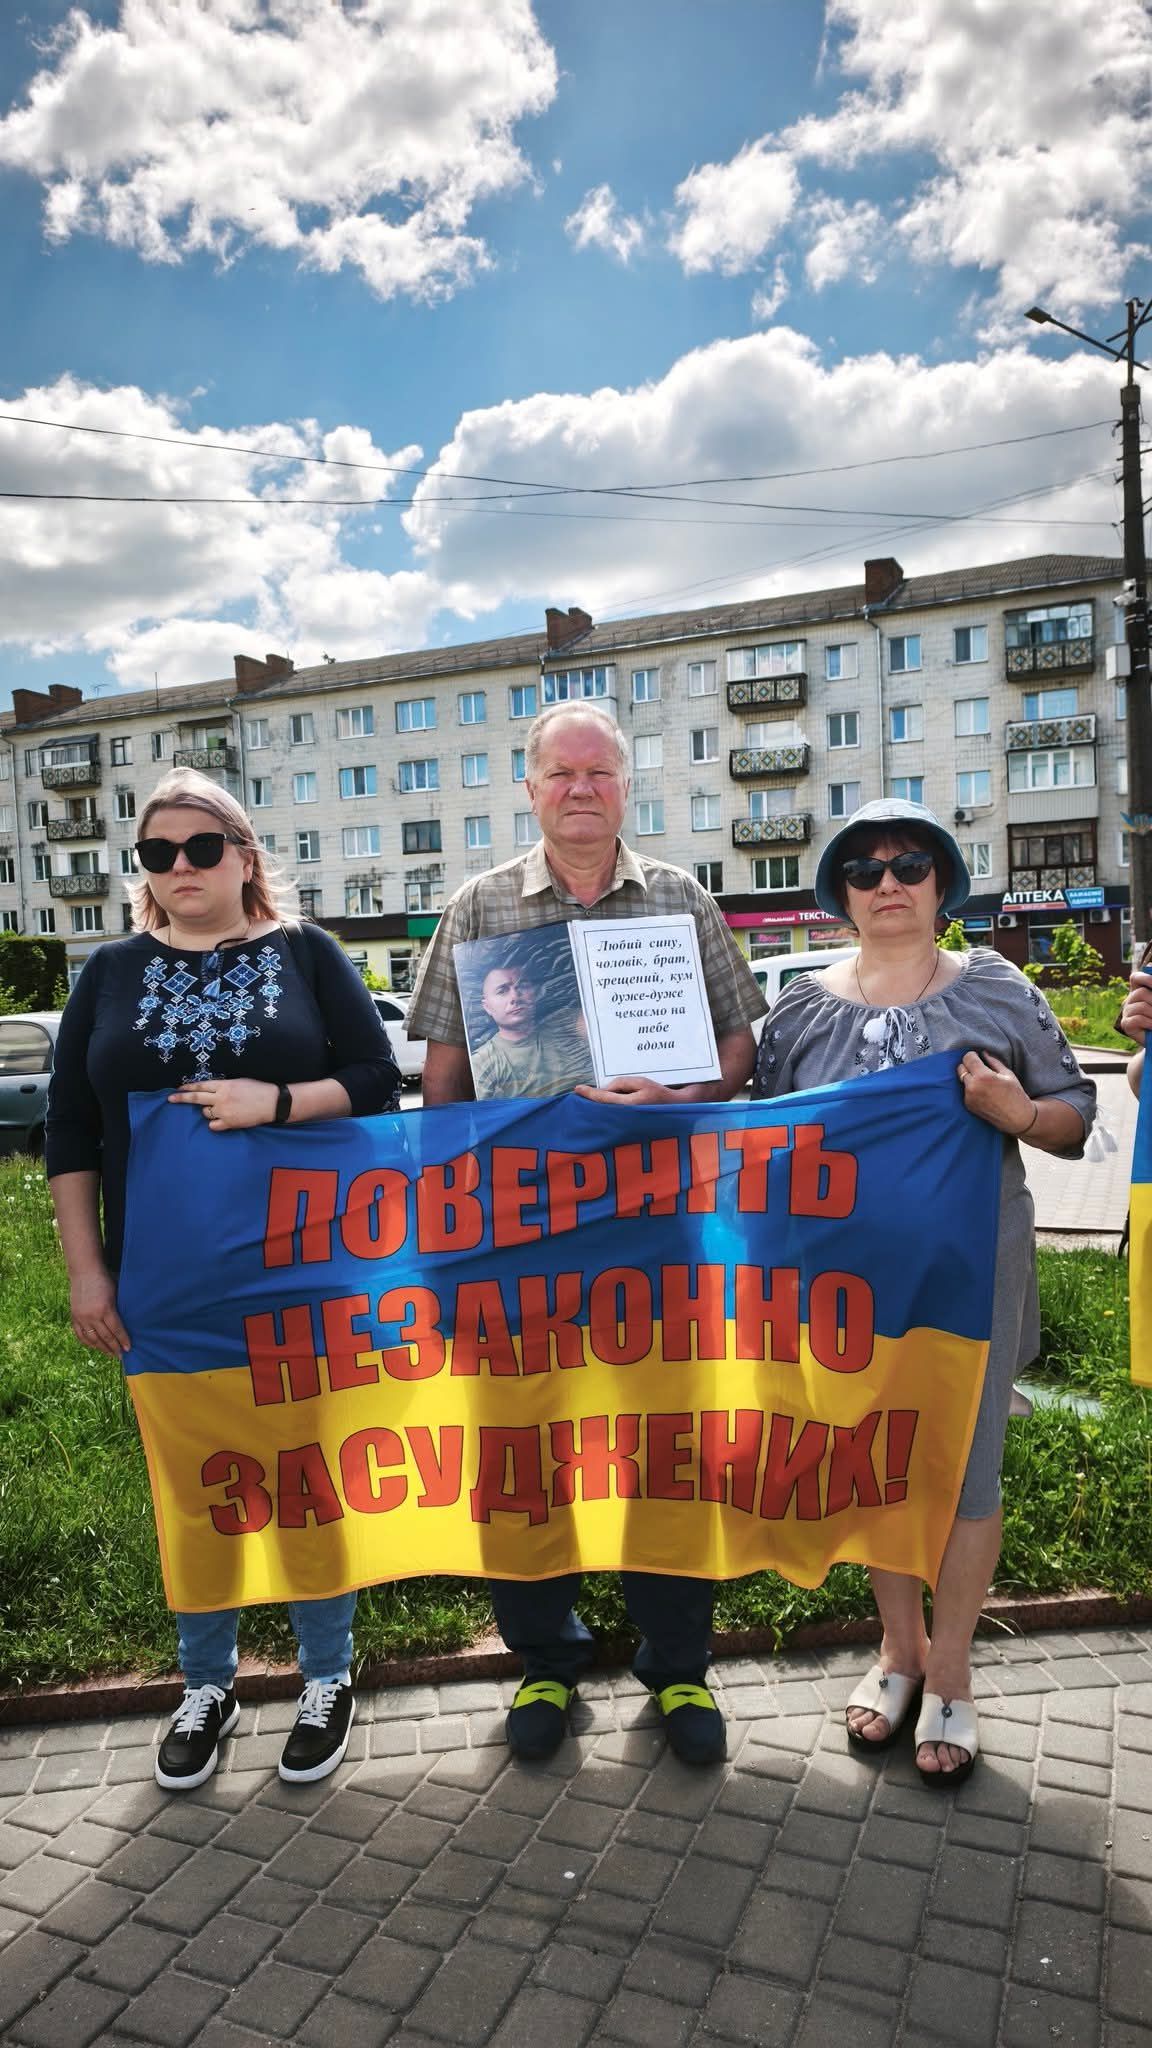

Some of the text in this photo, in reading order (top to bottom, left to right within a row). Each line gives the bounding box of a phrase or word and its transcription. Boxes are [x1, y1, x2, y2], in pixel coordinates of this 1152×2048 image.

[1002, 889, 1065, 904] АПТЕКА
[598, 938, 682, 952] Любий сину,
[596, 954, 690, 969] чоловік, брат,
[596, 972, 693, 989] хрещений, кум
[611, 989, 684, 1005] дуже-дуже
[671, 1006, 686, 1015] на
[638, 1022, 670, 1034] тебе
[637, 1040, 675, 1052] вдома
[262, 1123, 859, 1269] ПОВЕРНІТЬ
[243, 1264, 875, 1406] НЕЗАКОННО
[201, 1408, 920, 1536] ЗАСУДЖЕНИХ!
